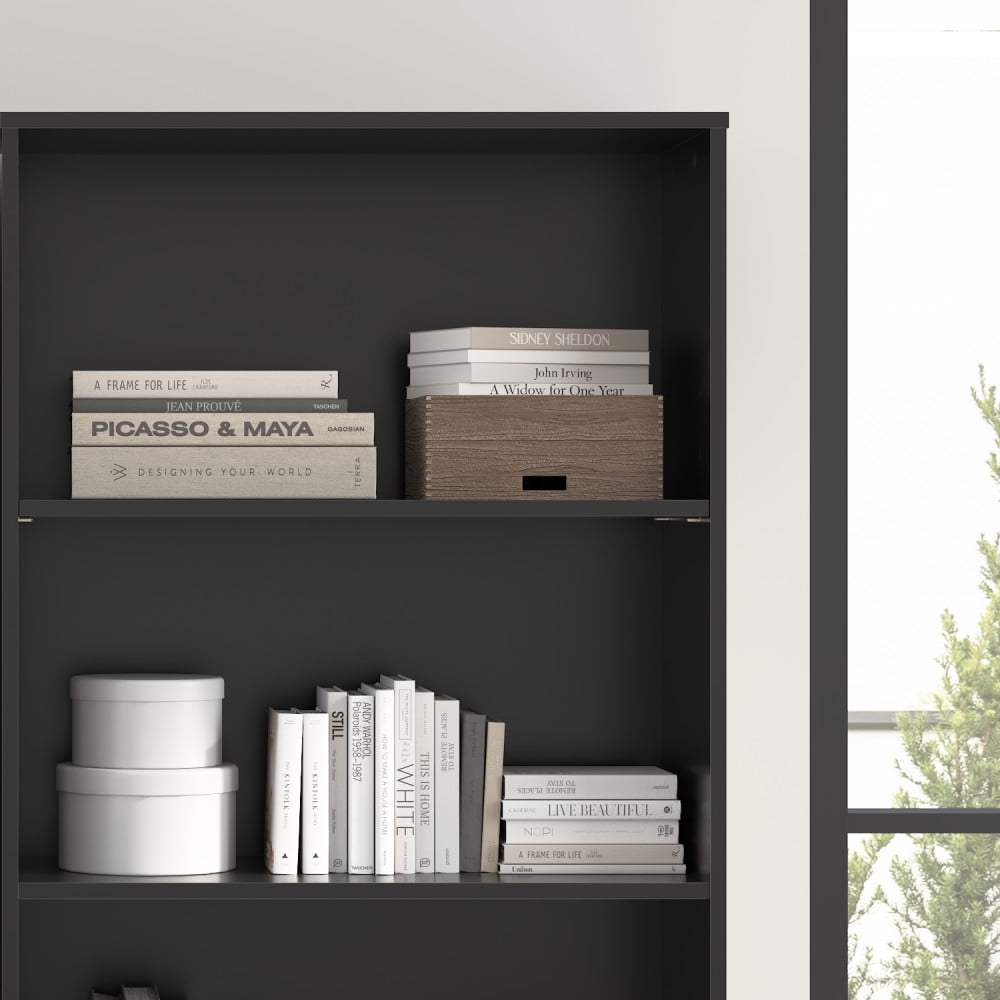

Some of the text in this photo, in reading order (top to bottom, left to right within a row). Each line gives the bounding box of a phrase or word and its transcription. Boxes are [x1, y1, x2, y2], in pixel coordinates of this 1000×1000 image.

[509, 332, 611, 347] SIDNEY SHELDON
[533, 366, 593, 382] John Irving
[93, 380, 188, 391] A FRAME FOR LIFE
[489, 384, 624, 396] A Widow for One Year
[165, 399, 242, 413] JEAN PROUVÉ
[91, 421, 314, 437] PICASSO & MAYA
[138, 467, 313, 477] DESIGNING YOUR WORLD
[331, 710, 345, 741] STILL
[352, 701, 362, 737] Polaroids
[362, 701, 372, 760] ANDY WARHOL
[440, 712, 448, 773] REMOTE PLACES
[448, 761, 455, 772] TO
[420, 751, 431, 828] THIS IS HOME
[396, 763, 415, 837] WHITE
[547, 803, 653, 817] LIVE BEAUTIFUL
[523, 826, 554, 837] NOPI
[518, 851, 524, 859] A
[527, 850, 551, 859] FRAME
[552, 850, 566, 860] FOR
[567, 851, 583, 860] LIFE
